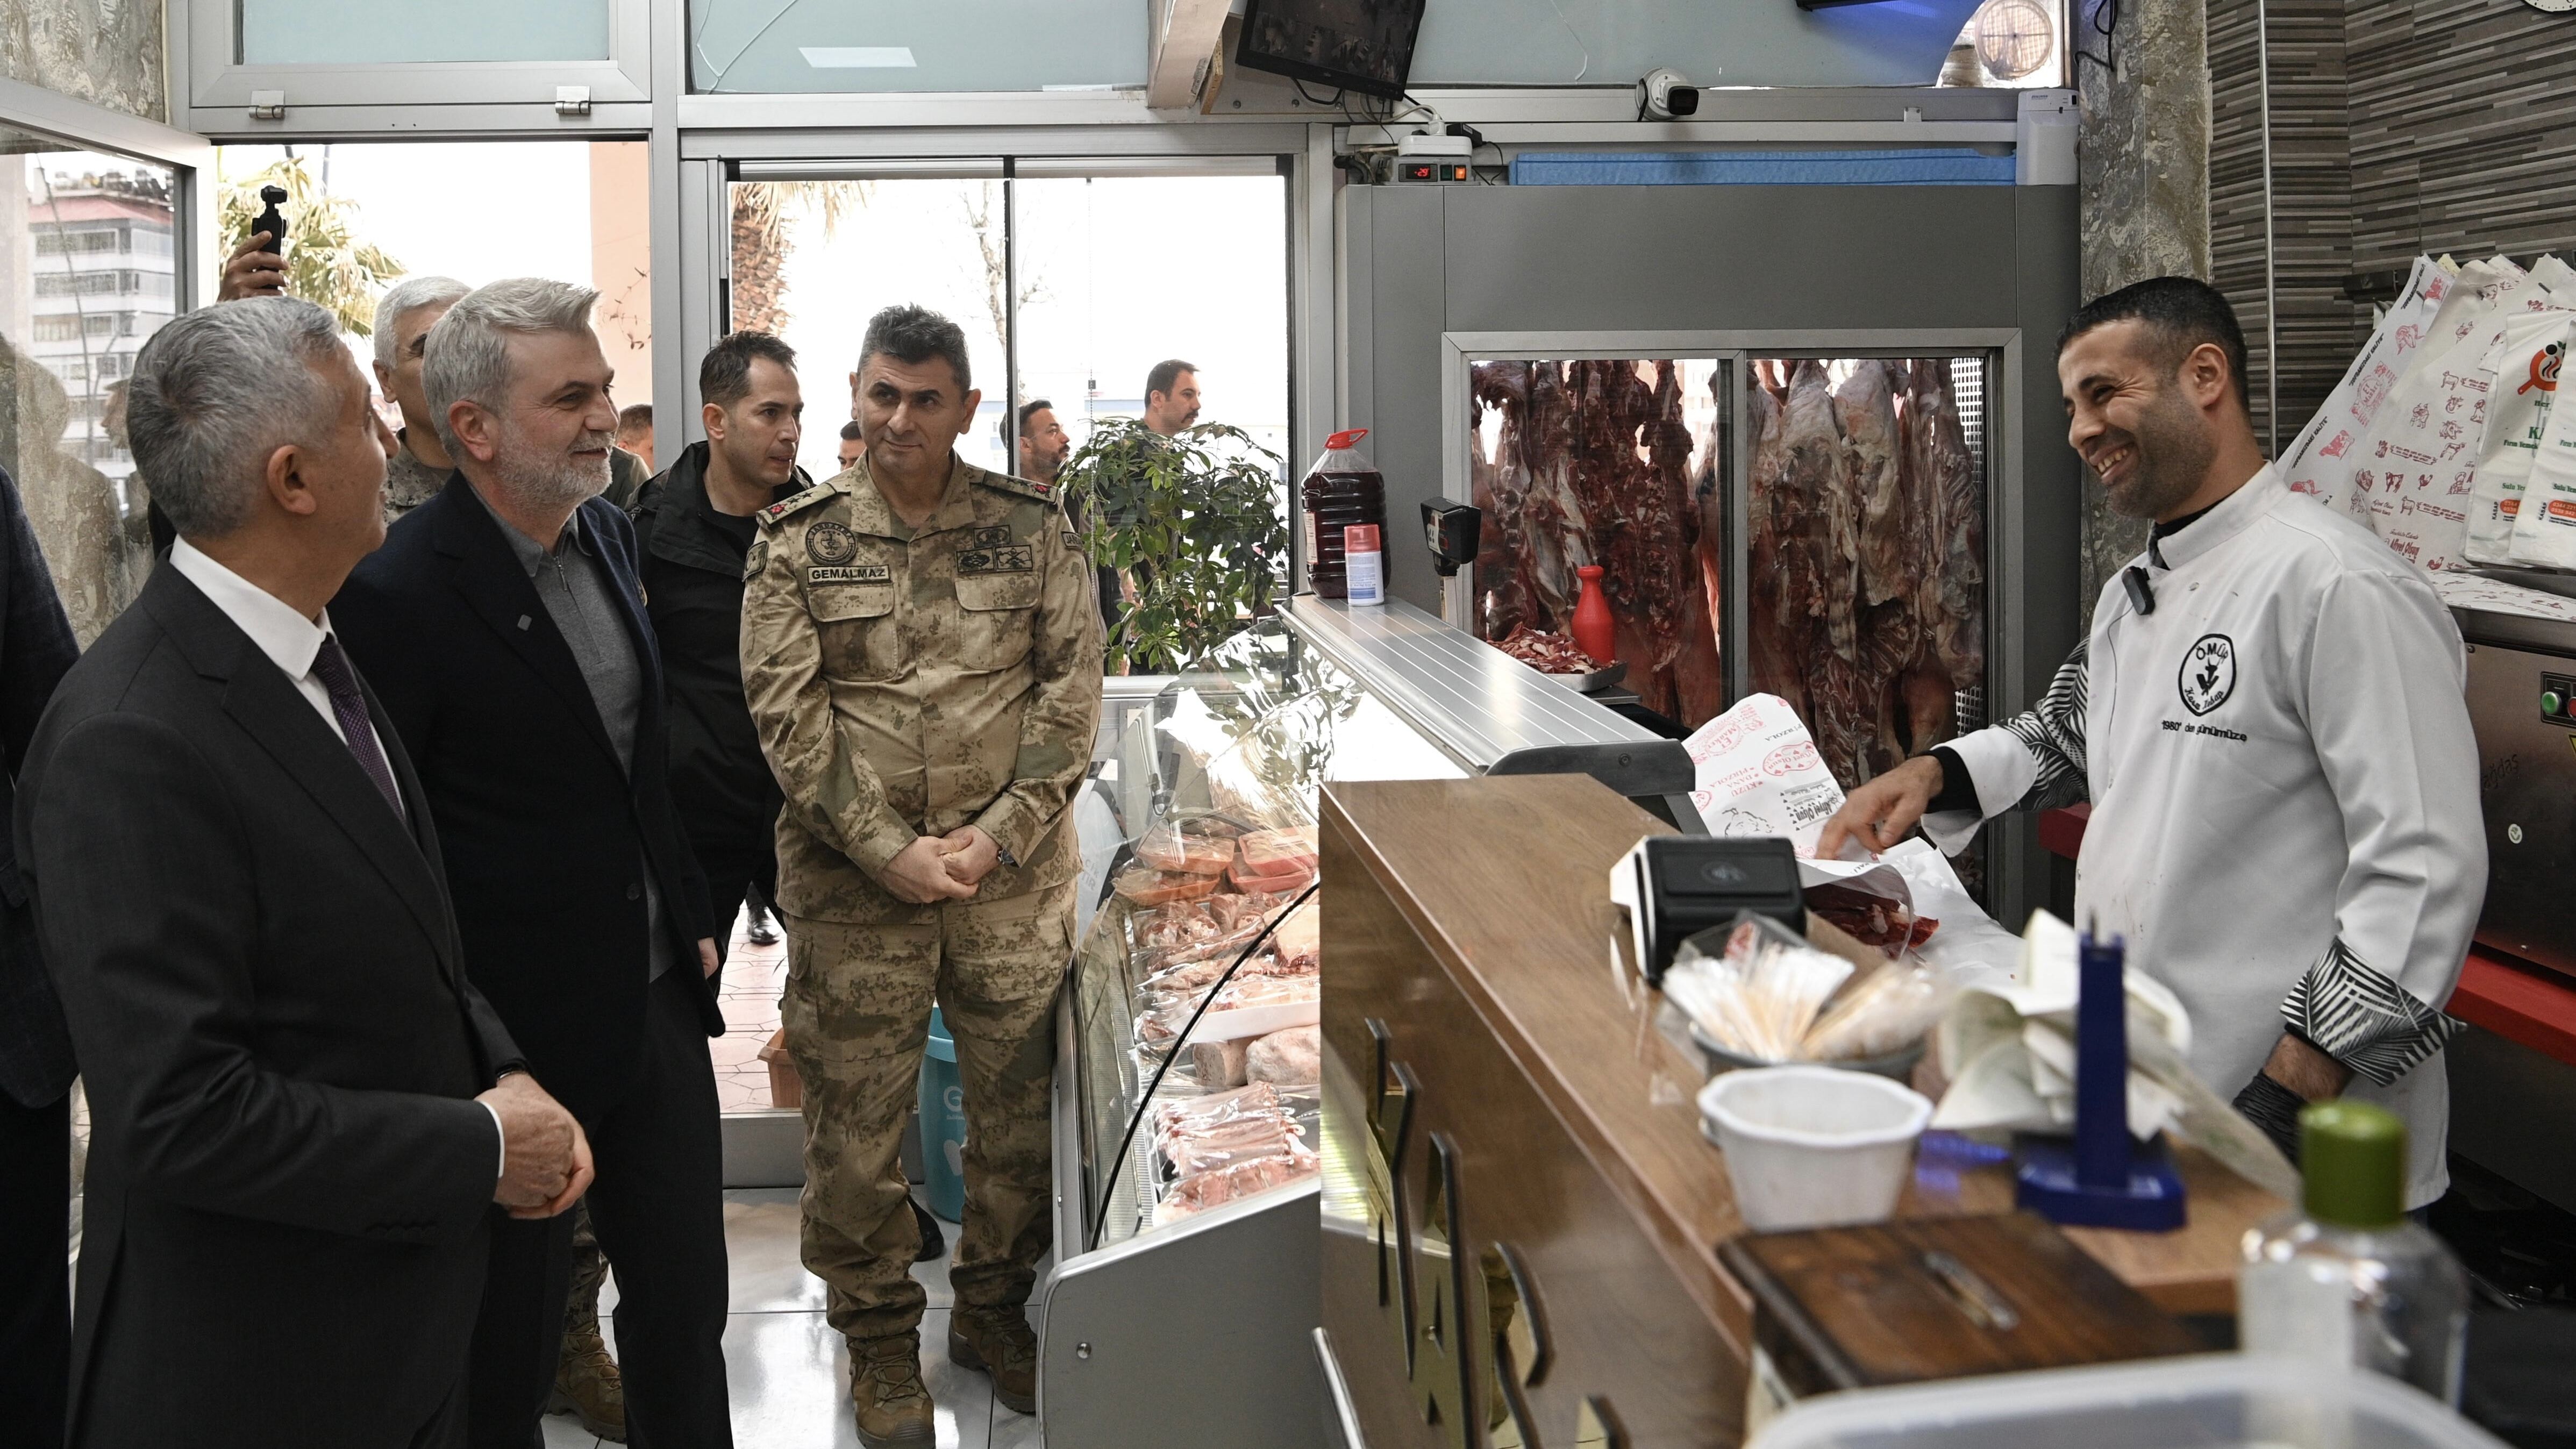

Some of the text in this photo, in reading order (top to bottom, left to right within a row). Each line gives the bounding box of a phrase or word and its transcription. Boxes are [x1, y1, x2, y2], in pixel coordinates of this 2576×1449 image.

[2538, 502, 2548, 520] KASAP
[812, 568, 886, 580] GEMALMAZ
[2482, 754, 2518, 792] ağdaş
[1731, 782, 1757, 797] KUZU
[1795, 808, 1815, 822] Olsun
